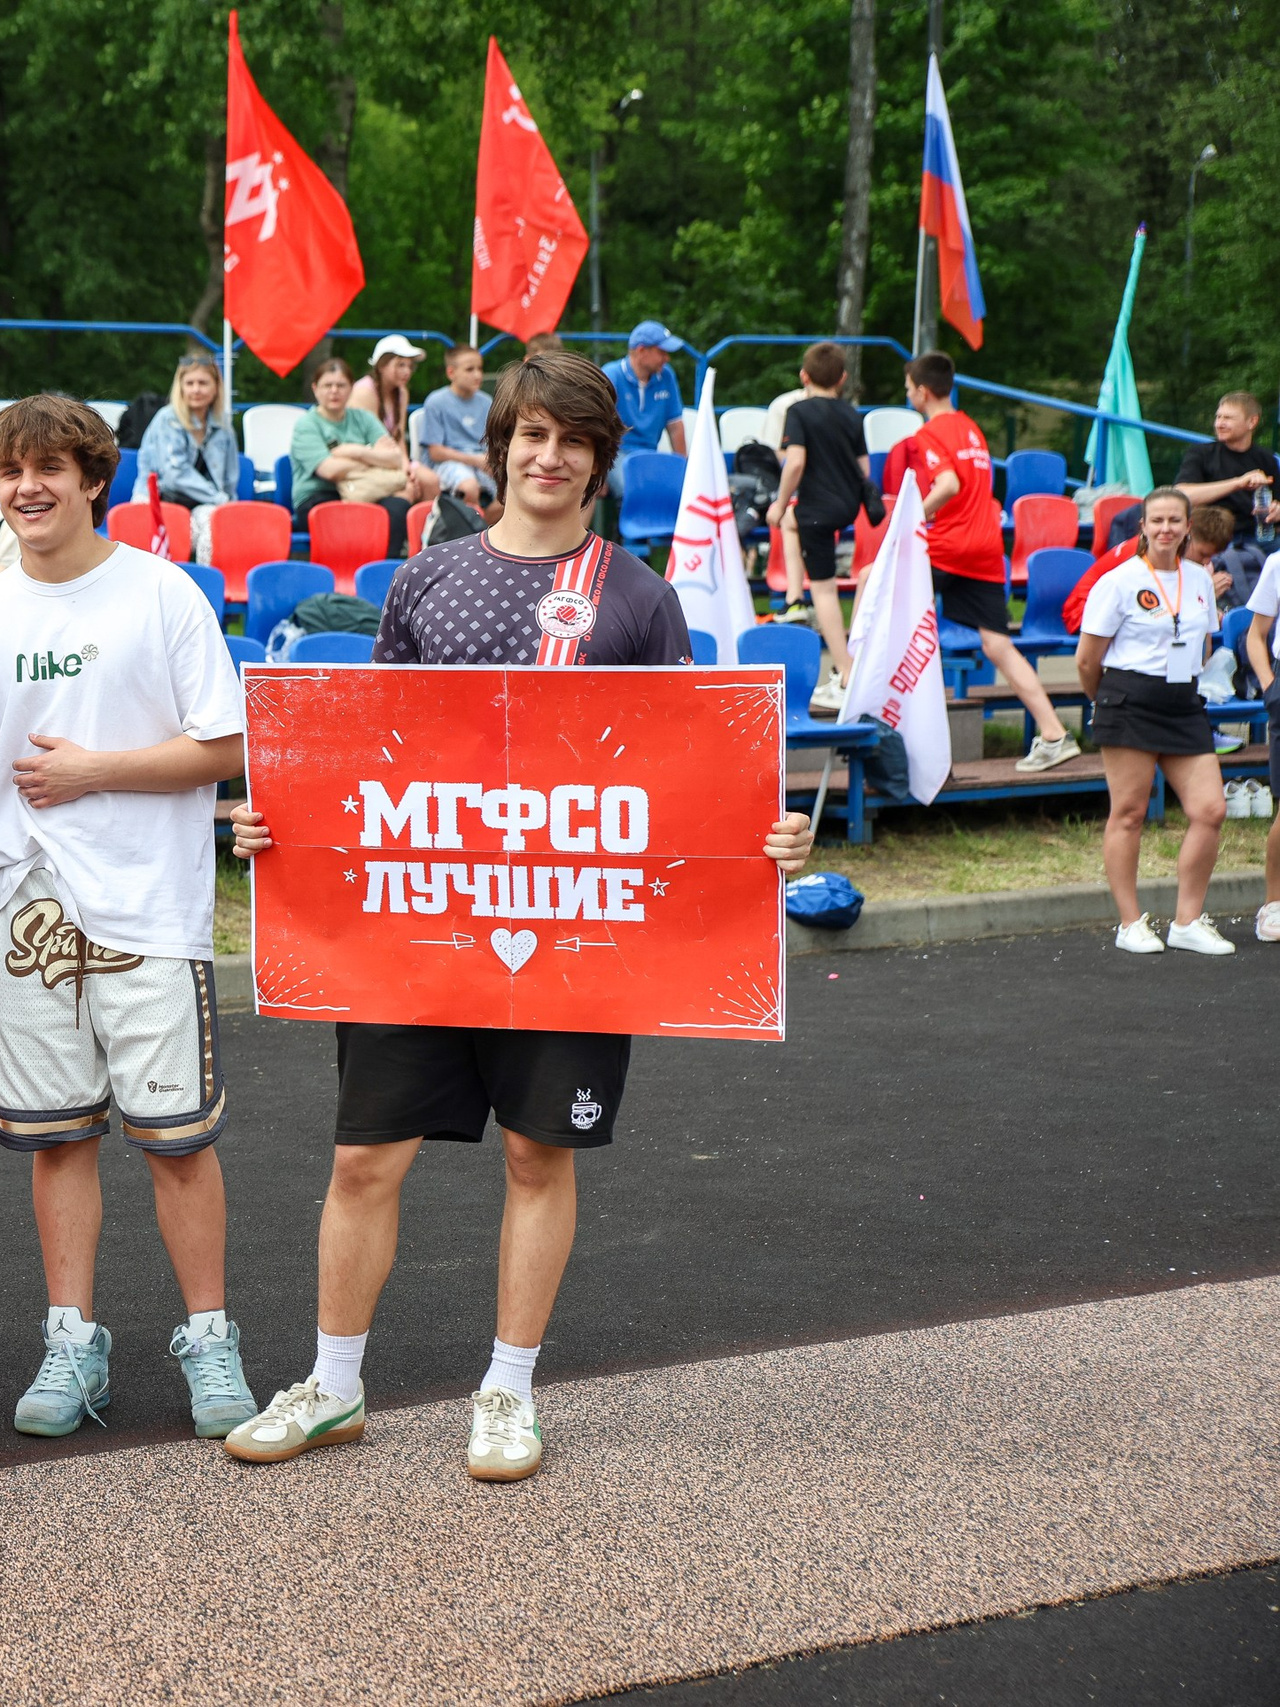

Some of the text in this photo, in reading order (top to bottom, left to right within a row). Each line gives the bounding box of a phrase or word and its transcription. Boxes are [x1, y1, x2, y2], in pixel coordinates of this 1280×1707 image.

[16, 651, 83, 682] Nike
[358, 780, 650, 854] МГФСО
[362, 861, 645, 922] ЛУЧШИЕ
